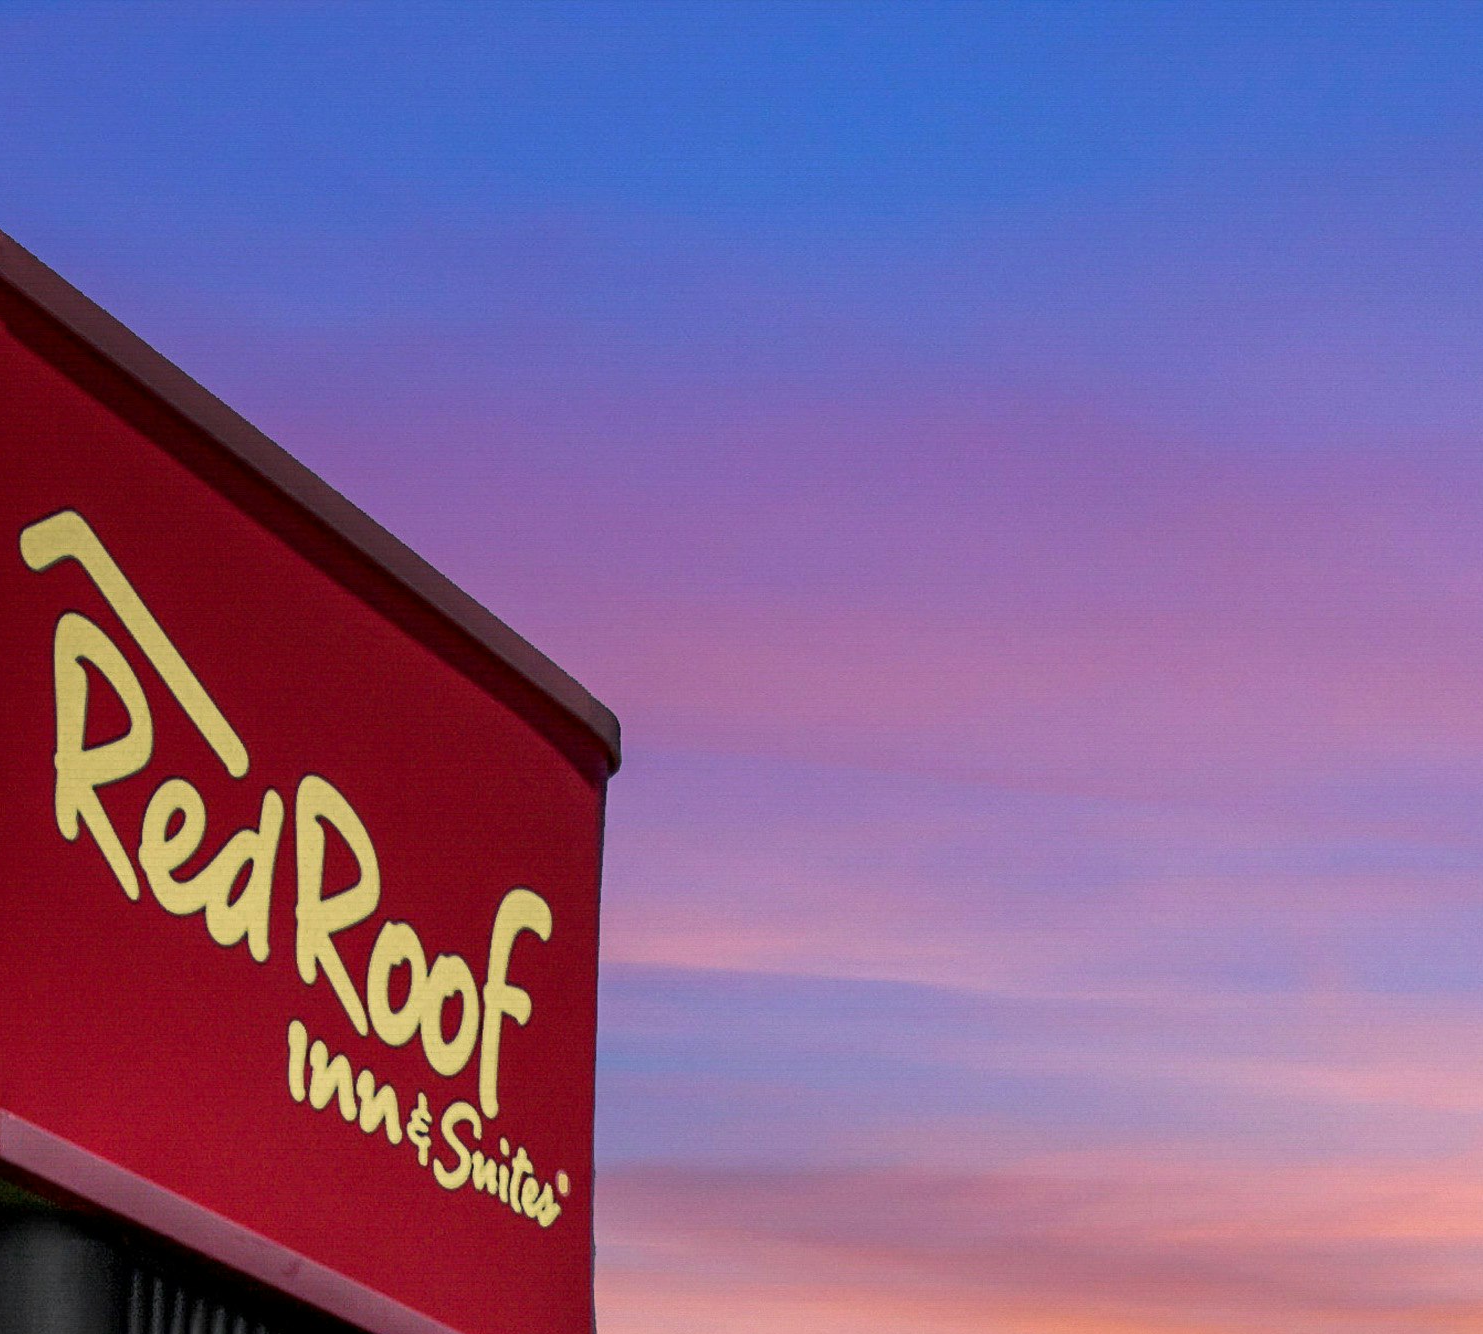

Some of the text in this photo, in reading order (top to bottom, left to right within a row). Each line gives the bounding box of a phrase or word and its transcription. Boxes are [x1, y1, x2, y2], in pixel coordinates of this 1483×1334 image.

[287, 1019, 562, 1229] Inn & Suites
